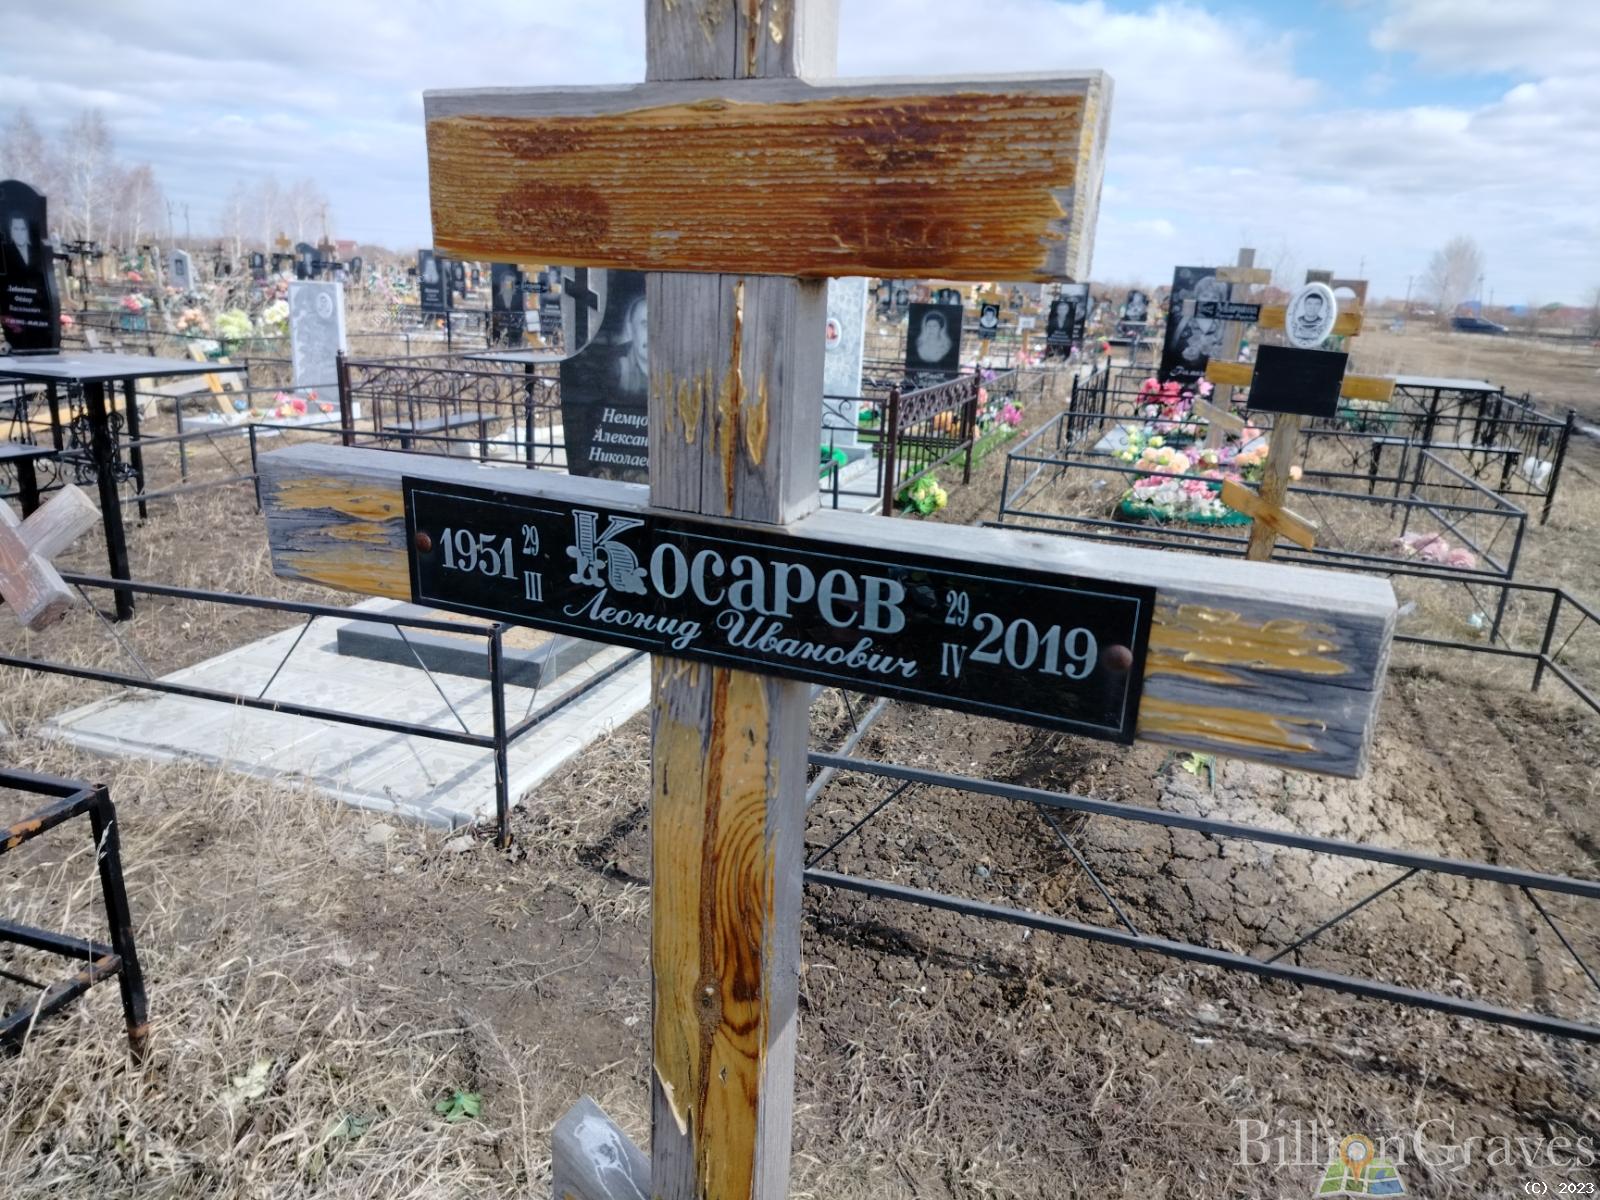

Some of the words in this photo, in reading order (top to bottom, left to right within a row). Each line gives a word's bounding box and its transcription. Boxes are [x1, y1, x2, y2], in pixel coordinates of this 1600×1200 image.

[602, 407, 649, 429] Немцо
[592, 427, 649, 447] Алексан
[588, 446, 649, 468] Николае
[439, 527, 519, 580] 1951
[522, 523, 540, 556] 29
[524, 570, 544, 602] III
[566, 508, 907, 635] Косарев
[563, 587, 703, 650] Леонид
[716, 608, 919, 679] Иванович
[945, 589, 970, 627] 29
[969, 611, 1098, 681] 2019
[940, 642, 968, 679] IV
